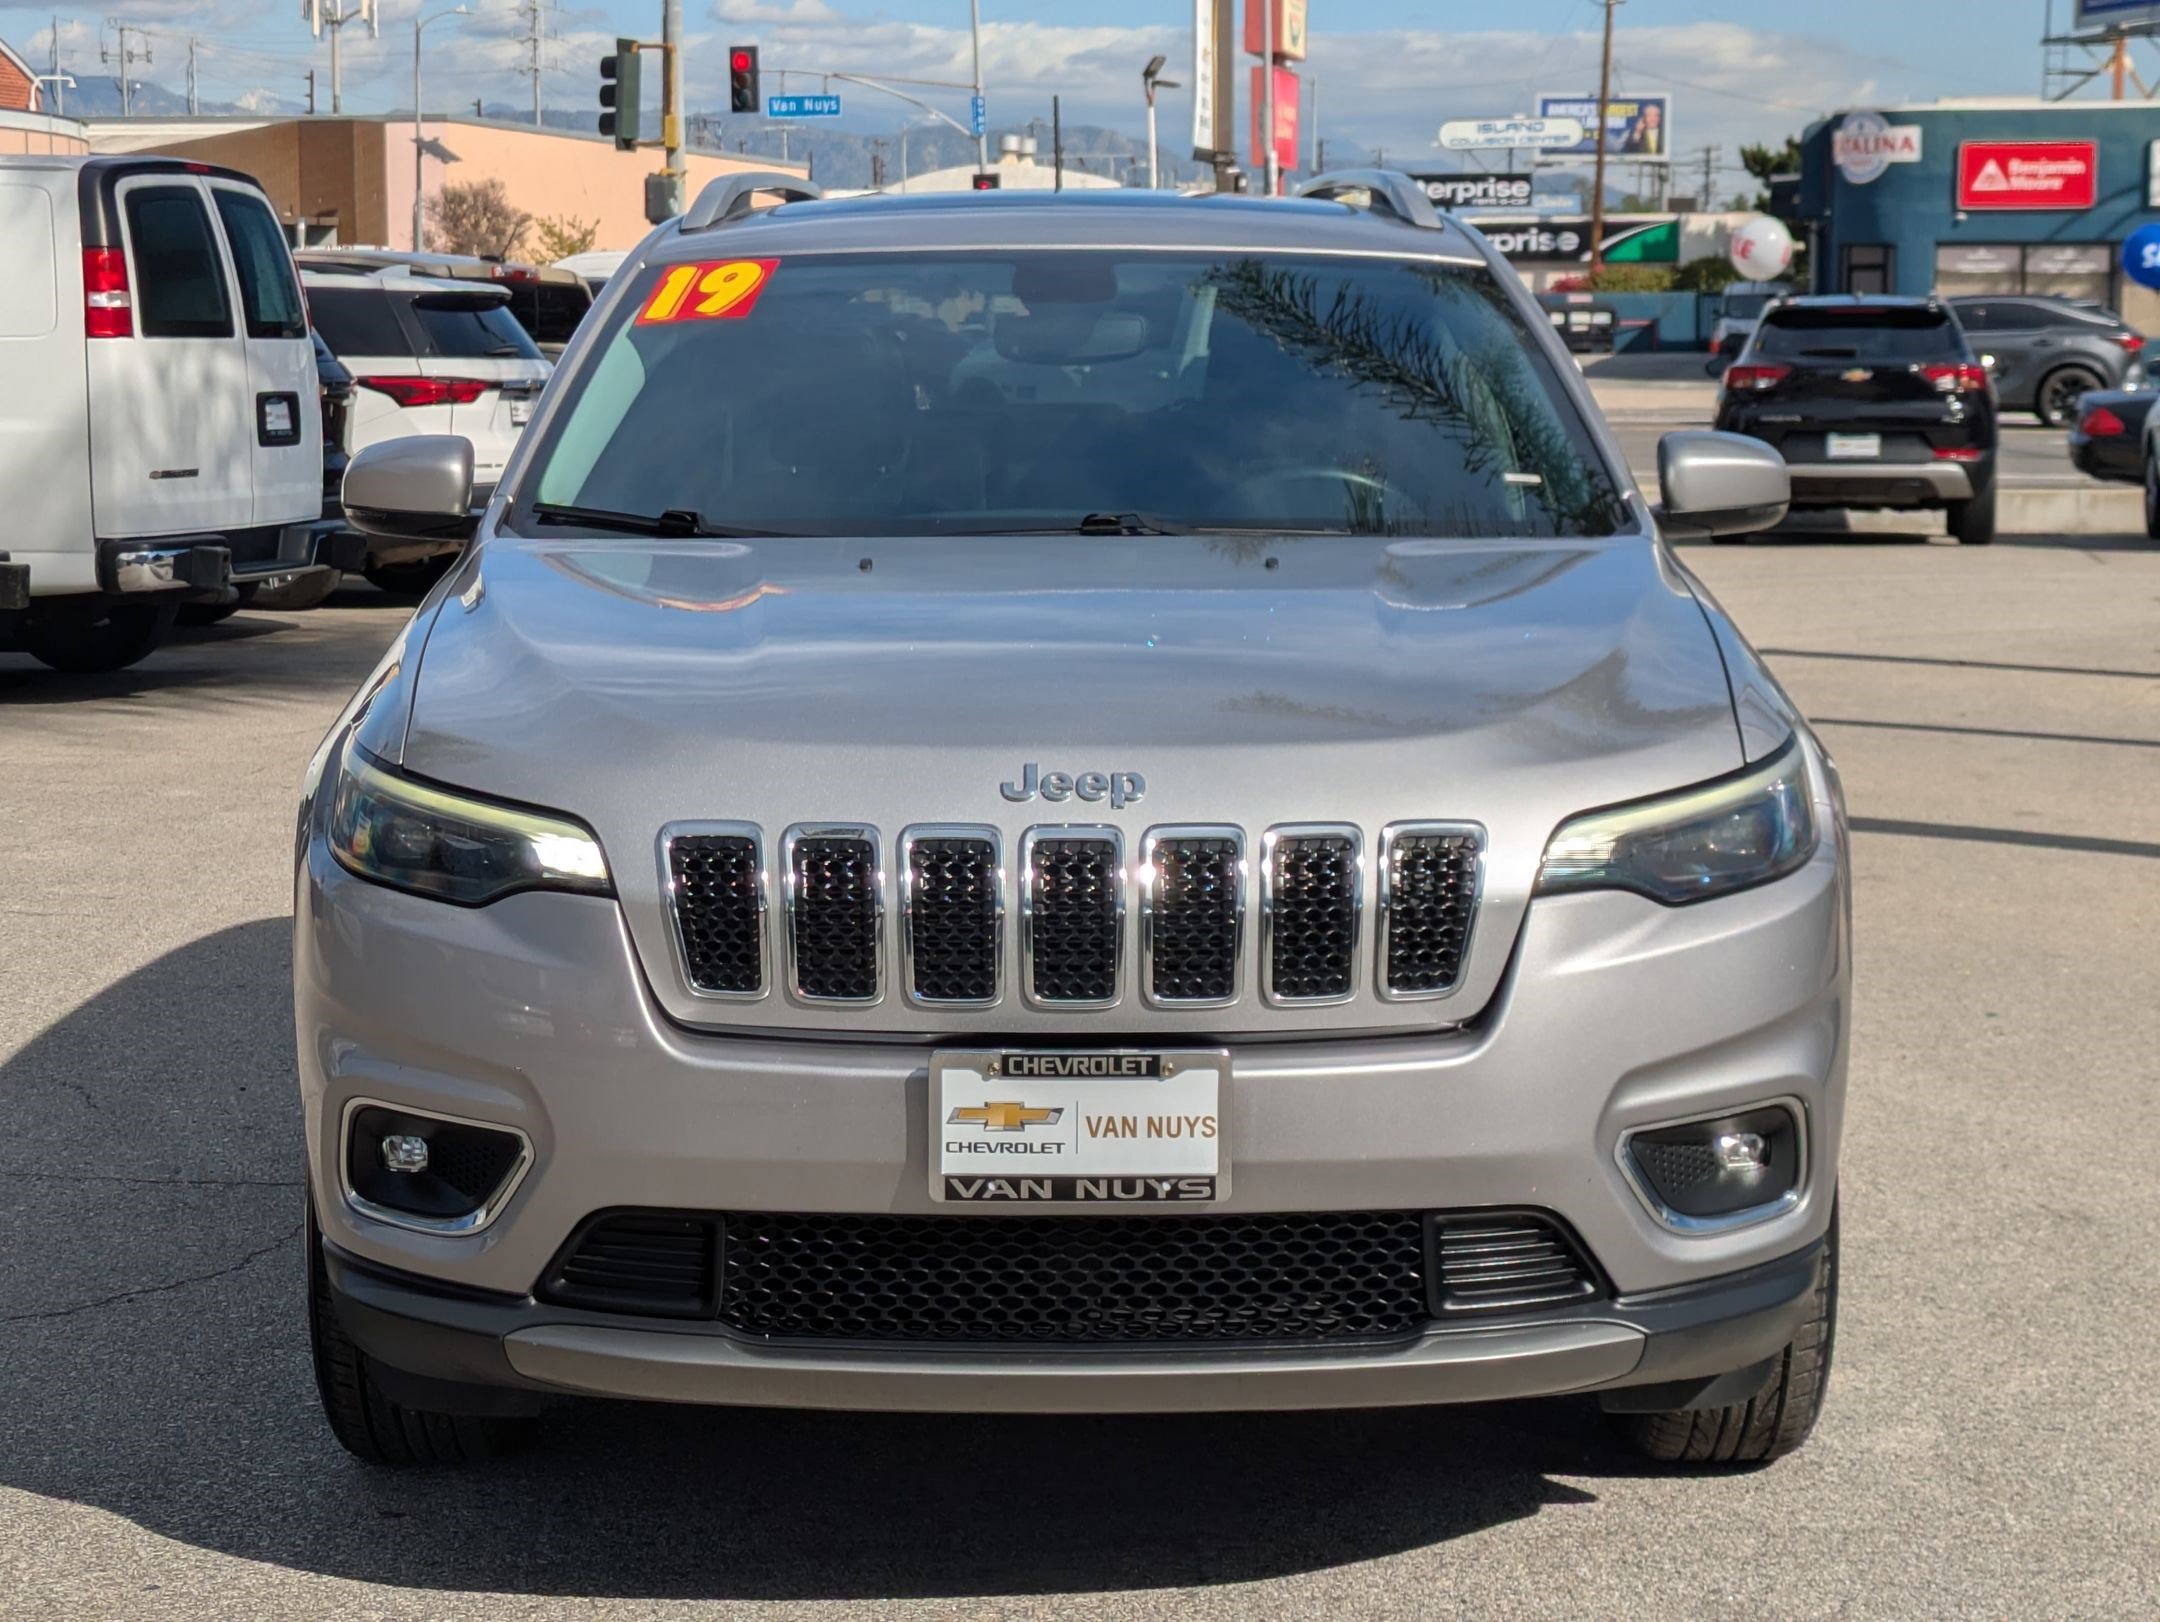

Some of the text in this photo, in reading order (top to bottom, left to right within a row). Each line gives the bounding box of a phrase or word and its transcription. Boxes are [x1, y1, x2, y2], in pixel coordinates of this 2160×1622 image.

[773, 98, 838, 112] Van Nuys
[1477, 122, 1545, 134] ISLAND
[644, 261, 765, 320] 19
[1000, 763, 1146, 809] Jeep
[1008, 1056, 1152, 1076] CHEVROLET
[1086, 1115, 1217, 1139] VAN NUYS
[945, 1141, 1066, 1155] CHEVROLET
[949, 1178, 1212, 1199] VAN NUYS
